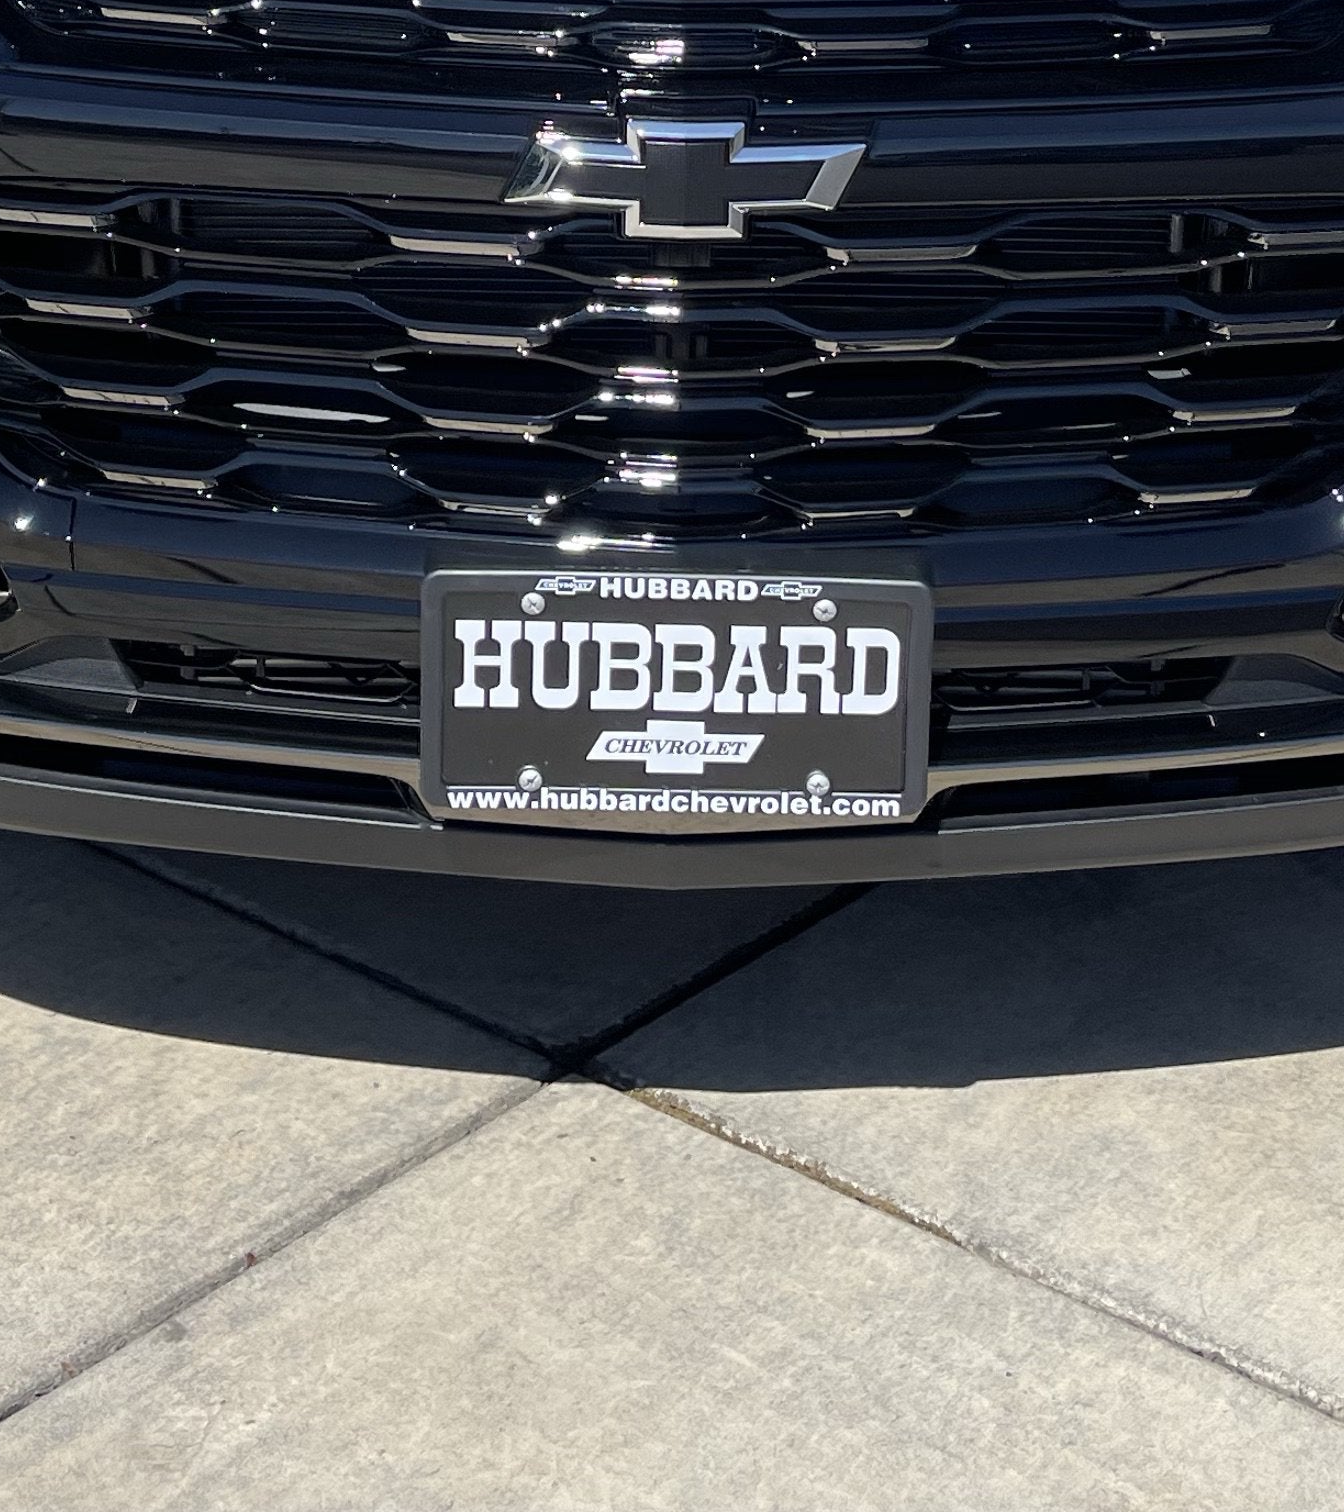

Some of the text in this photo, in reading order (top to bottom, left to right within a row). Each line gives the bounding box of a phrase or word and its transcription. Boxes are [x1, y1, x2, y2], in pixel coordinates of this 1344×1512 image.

[599, 576, 760, 601] HUBBARD
[454, 618, 902, 716] HUBBARD
[604, 738, 747, 756] CHEVROLET
[446, 786, 902, 817] www.hubbardchevrolet.com
